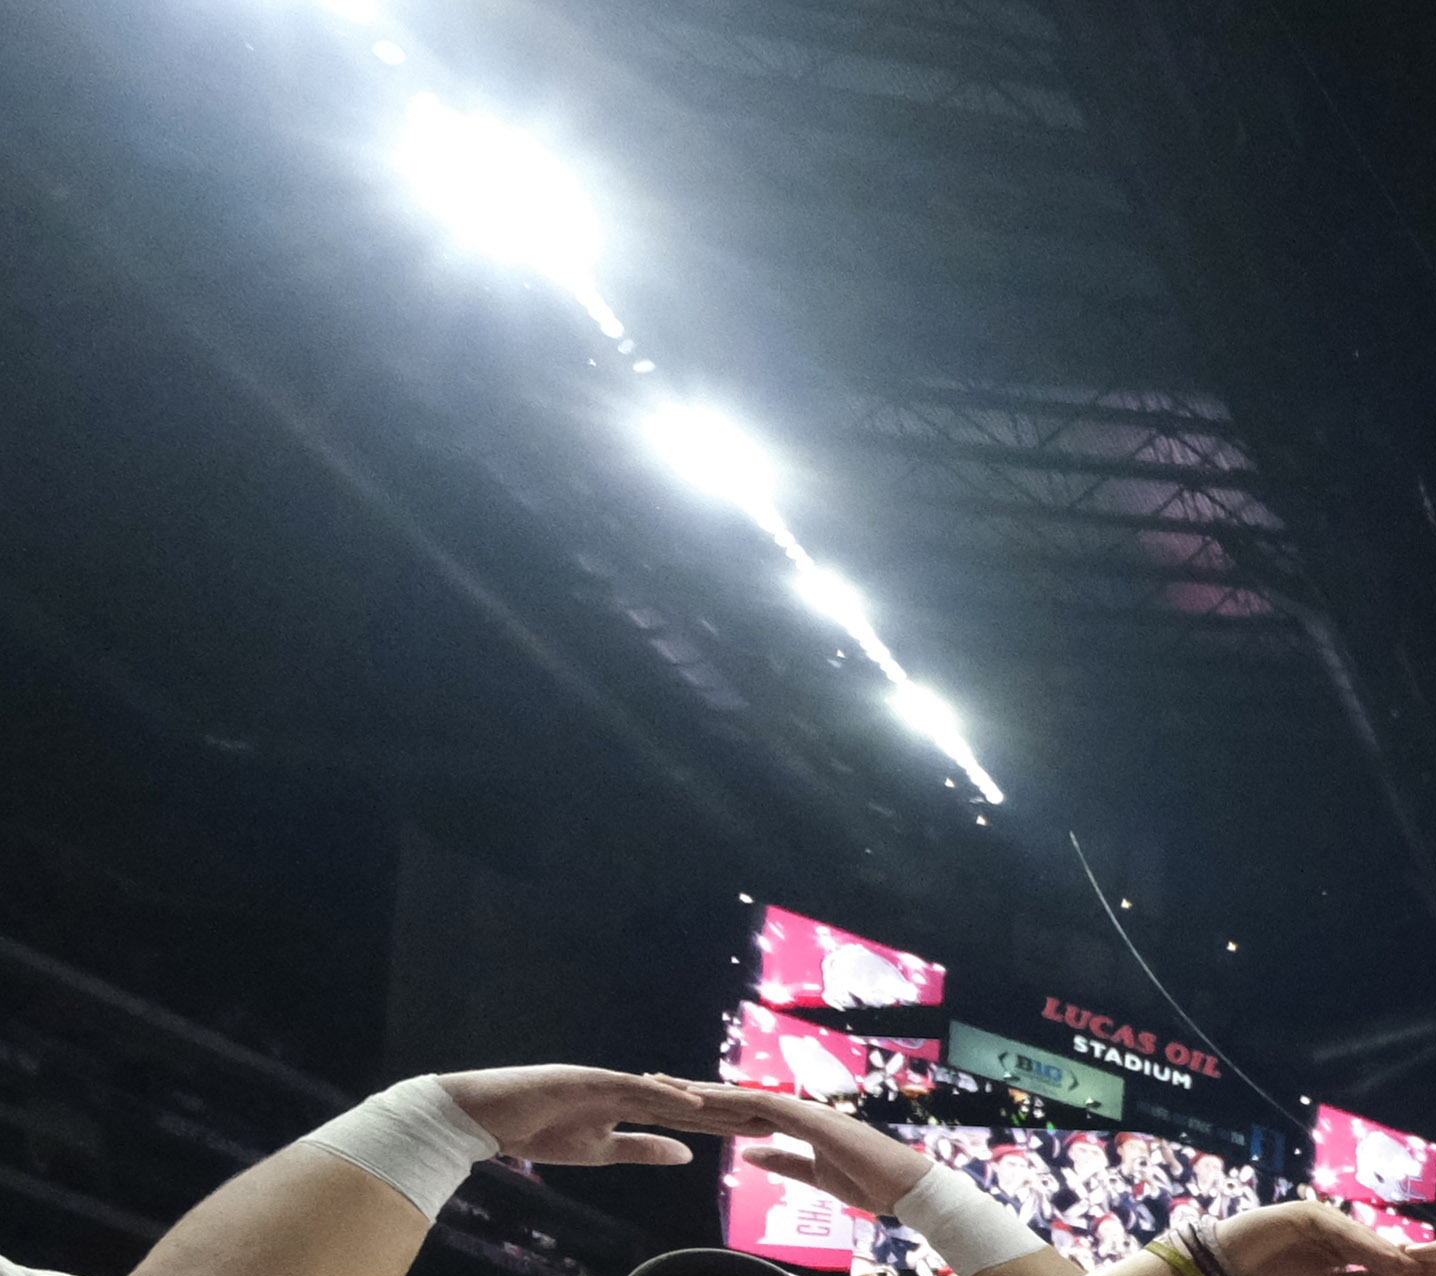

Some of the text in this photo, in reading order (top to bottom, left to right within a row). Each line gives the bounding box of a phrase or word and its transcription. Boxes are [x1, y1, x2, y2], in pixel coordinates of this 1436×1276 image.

[1042, 997, 1221, 1078] LUCAS OIL
[1073, 1035, 1192, 1091] STADIUM
